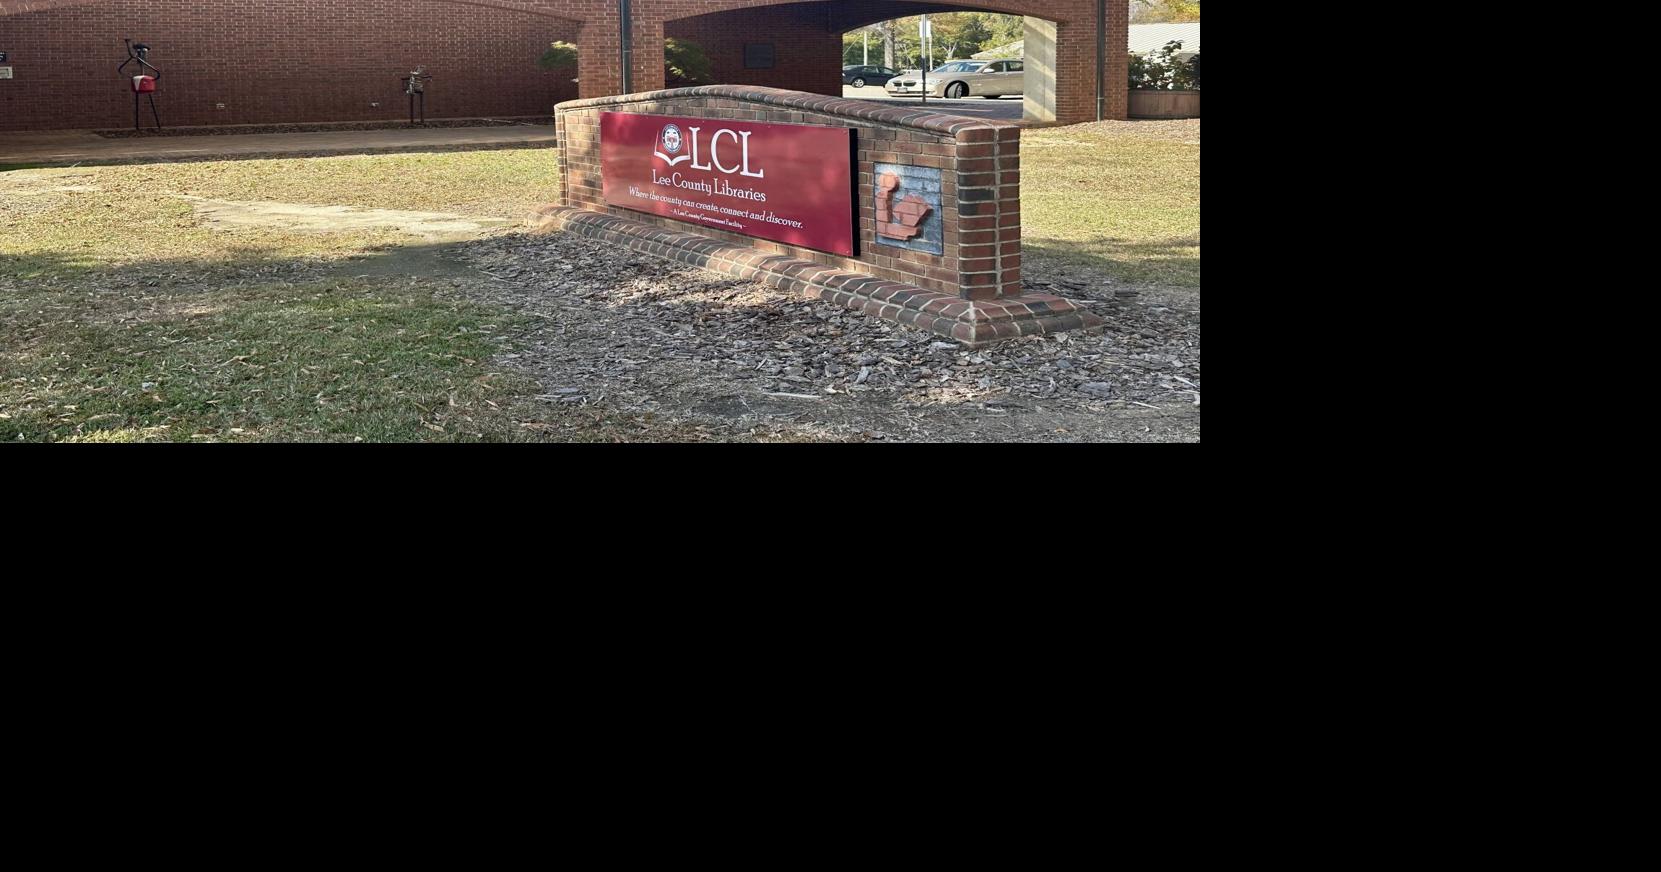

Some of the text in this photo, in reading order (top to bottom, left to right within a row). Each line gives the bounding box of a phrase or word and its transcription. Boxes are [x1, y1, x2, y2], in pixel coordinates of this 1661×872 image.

[689, 126, 764, 178] LCL
[629, 185, 803, 229] Where the county can create, connect and discover.
[652, 169, 766, 202] Lee County Libraries
